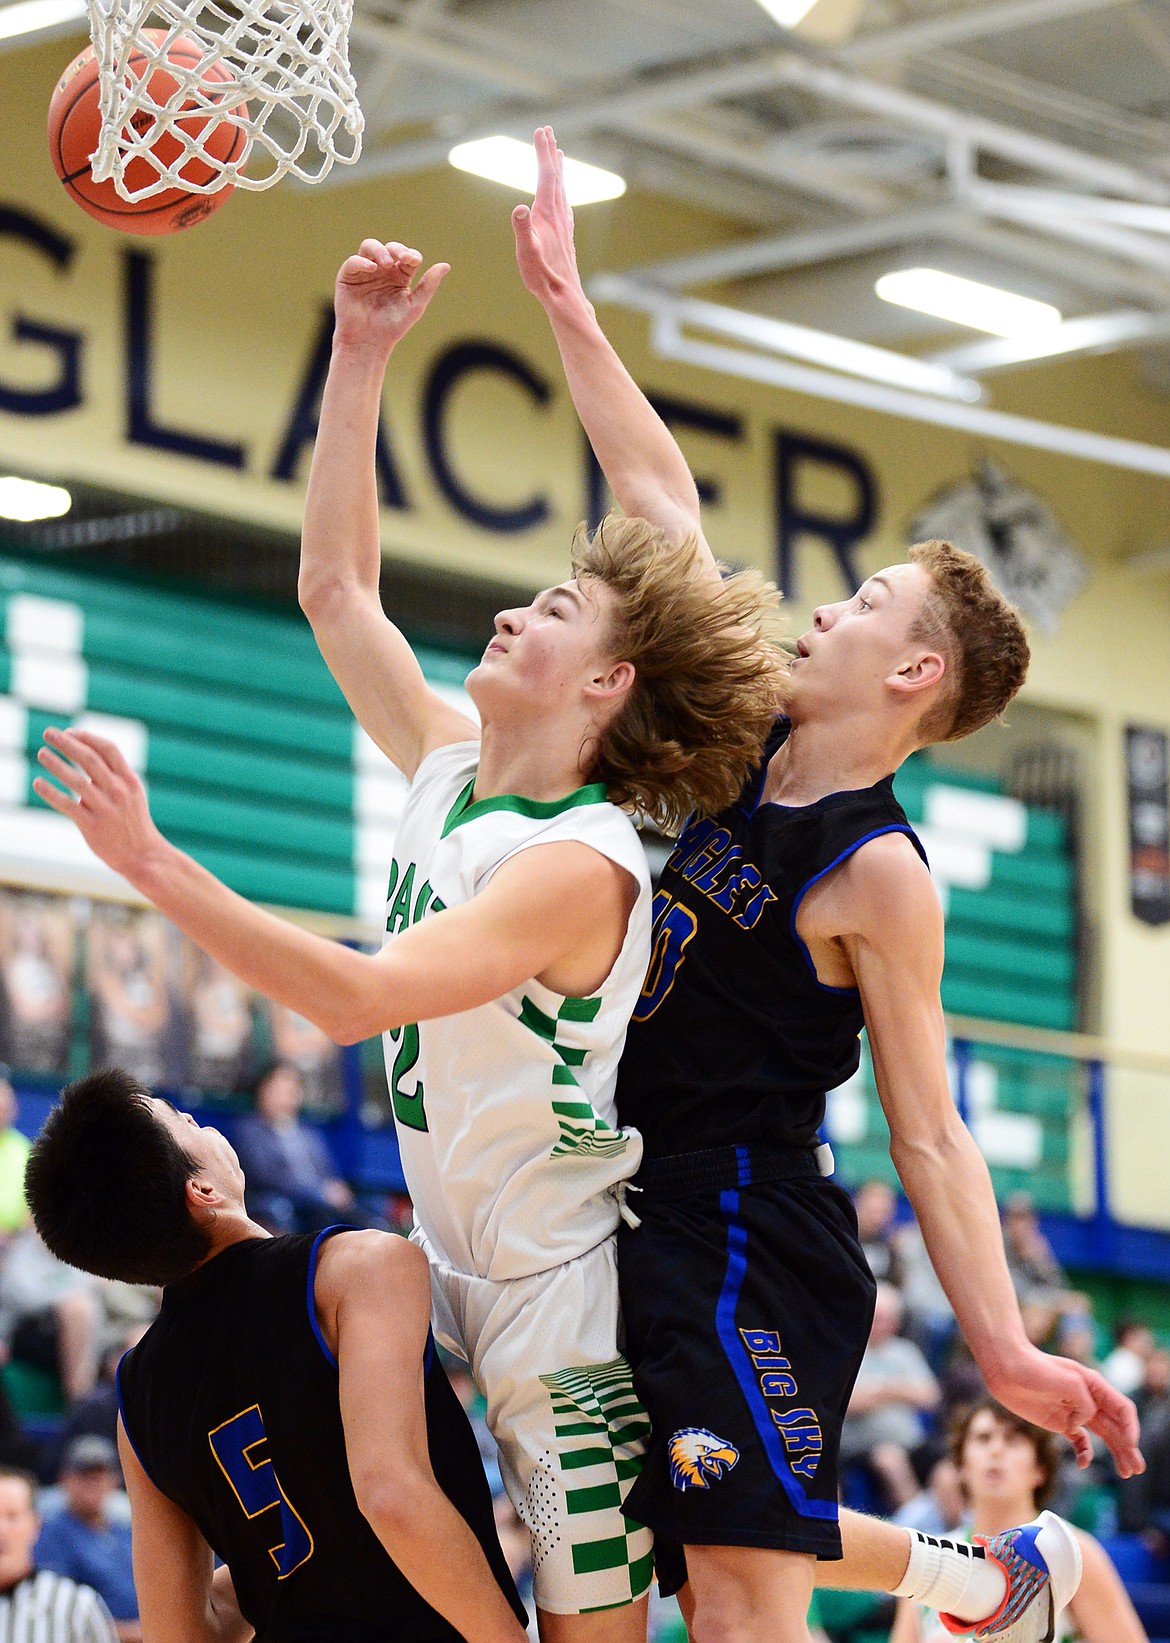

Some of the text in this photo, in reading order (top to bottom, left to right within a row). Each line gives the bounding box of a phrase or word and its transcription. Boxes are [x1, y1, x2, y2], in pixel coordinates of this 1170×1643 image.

[668, 812, 779, 930] AGLES
[739, 1327, 823, 1479] BIG SKY
[208, 1403, 314, 1580] 5
